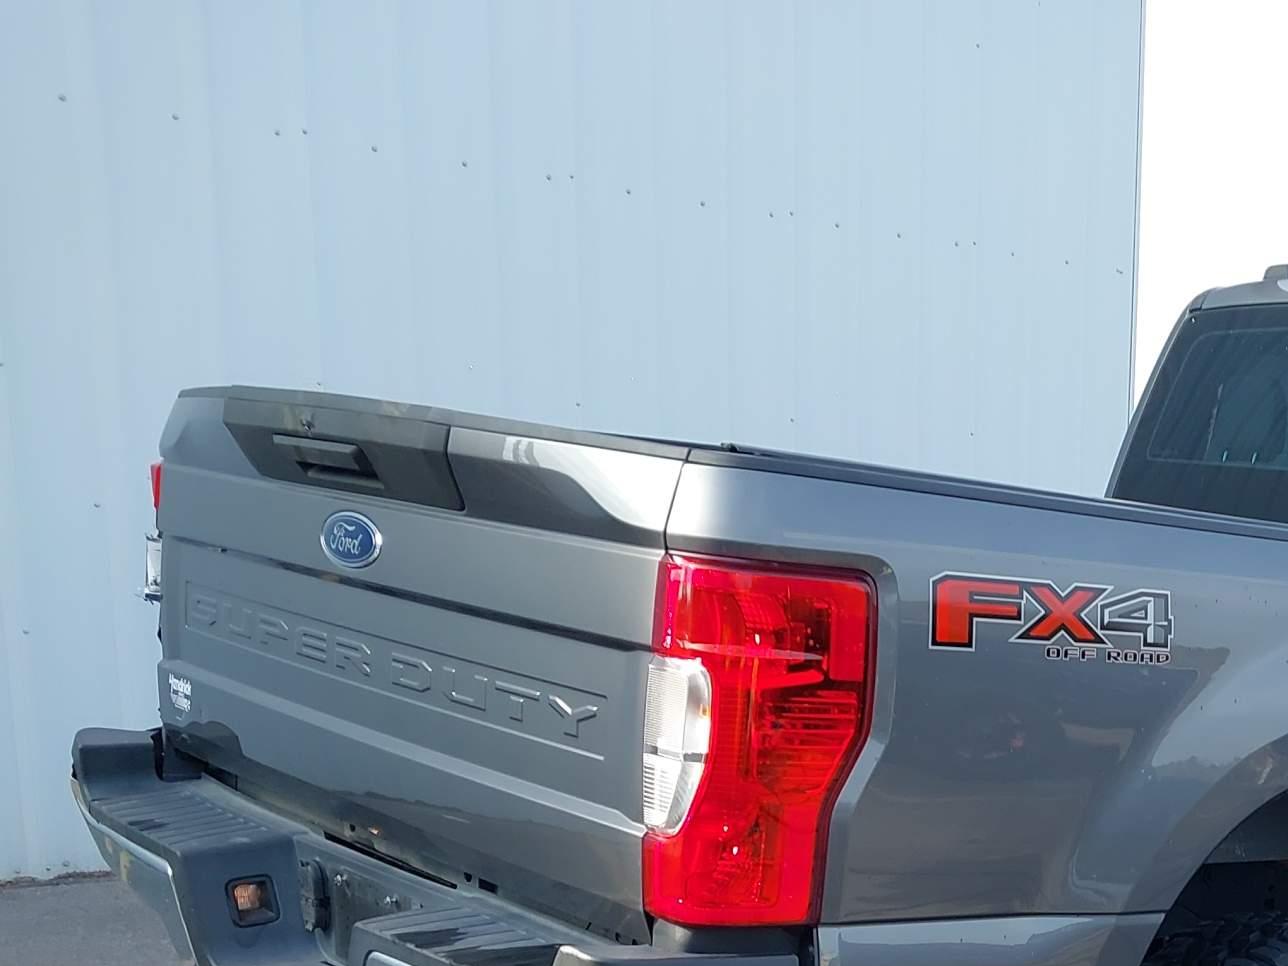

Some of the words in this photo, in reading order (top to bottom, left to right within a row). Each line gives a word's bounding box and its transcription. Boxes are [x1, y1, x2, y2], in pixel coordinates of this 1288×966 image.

[330, 521, 363, 555] Ford
[929, 571, 1174, 650] FX4
[190, 594, 372, 678] SUPER
[391, 652, 600, 738] DUTY
[1045, 646, 1096, 661] OFF
[1105, 650, 1171, 665] ROAD
